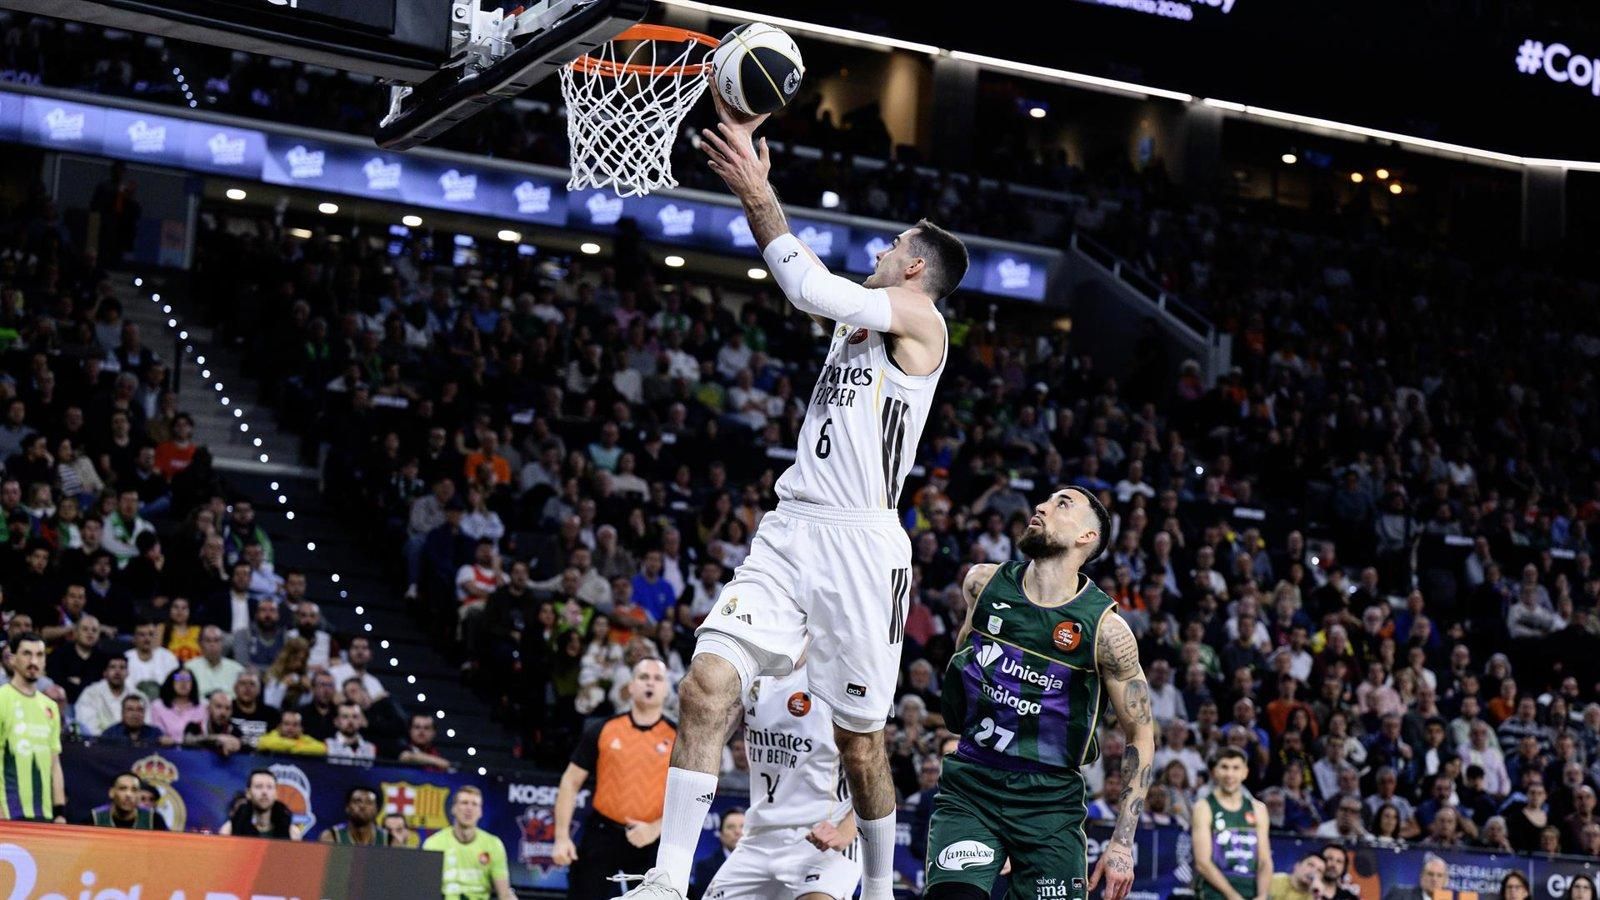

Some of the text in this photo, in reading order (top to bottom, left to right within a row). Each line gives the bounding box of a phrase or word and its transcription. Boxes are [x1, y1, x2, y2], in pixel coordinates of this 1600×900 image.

[815, 418, 832, 459] 6
[1001, 657, 1063, 691] Unicaja
[747, 725, 813, 753] mirates
[974, 717, 1015, 752] 27
